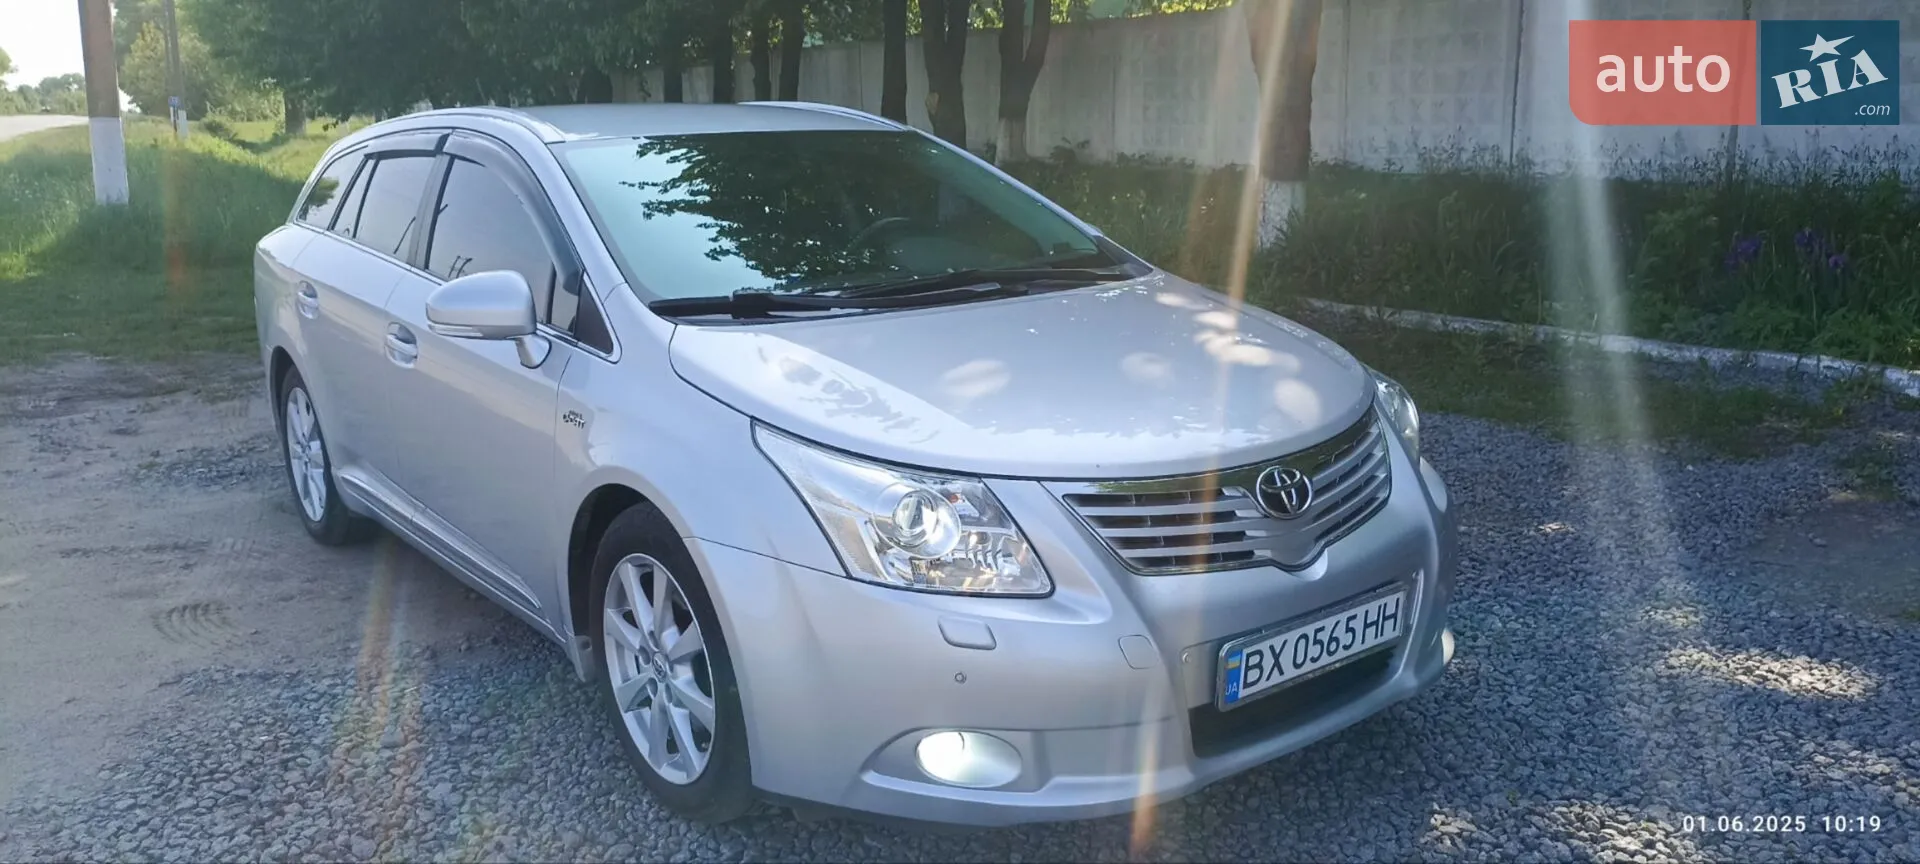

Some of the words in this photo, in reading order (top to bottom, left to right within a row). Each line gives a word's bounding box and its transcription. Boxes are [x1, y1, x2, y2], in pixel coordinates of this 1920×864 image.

[1243, 639, 1288, 690] BX
[1292, 614, 1358, 670] 0565
[1361, 597, 1400, 645] HH
